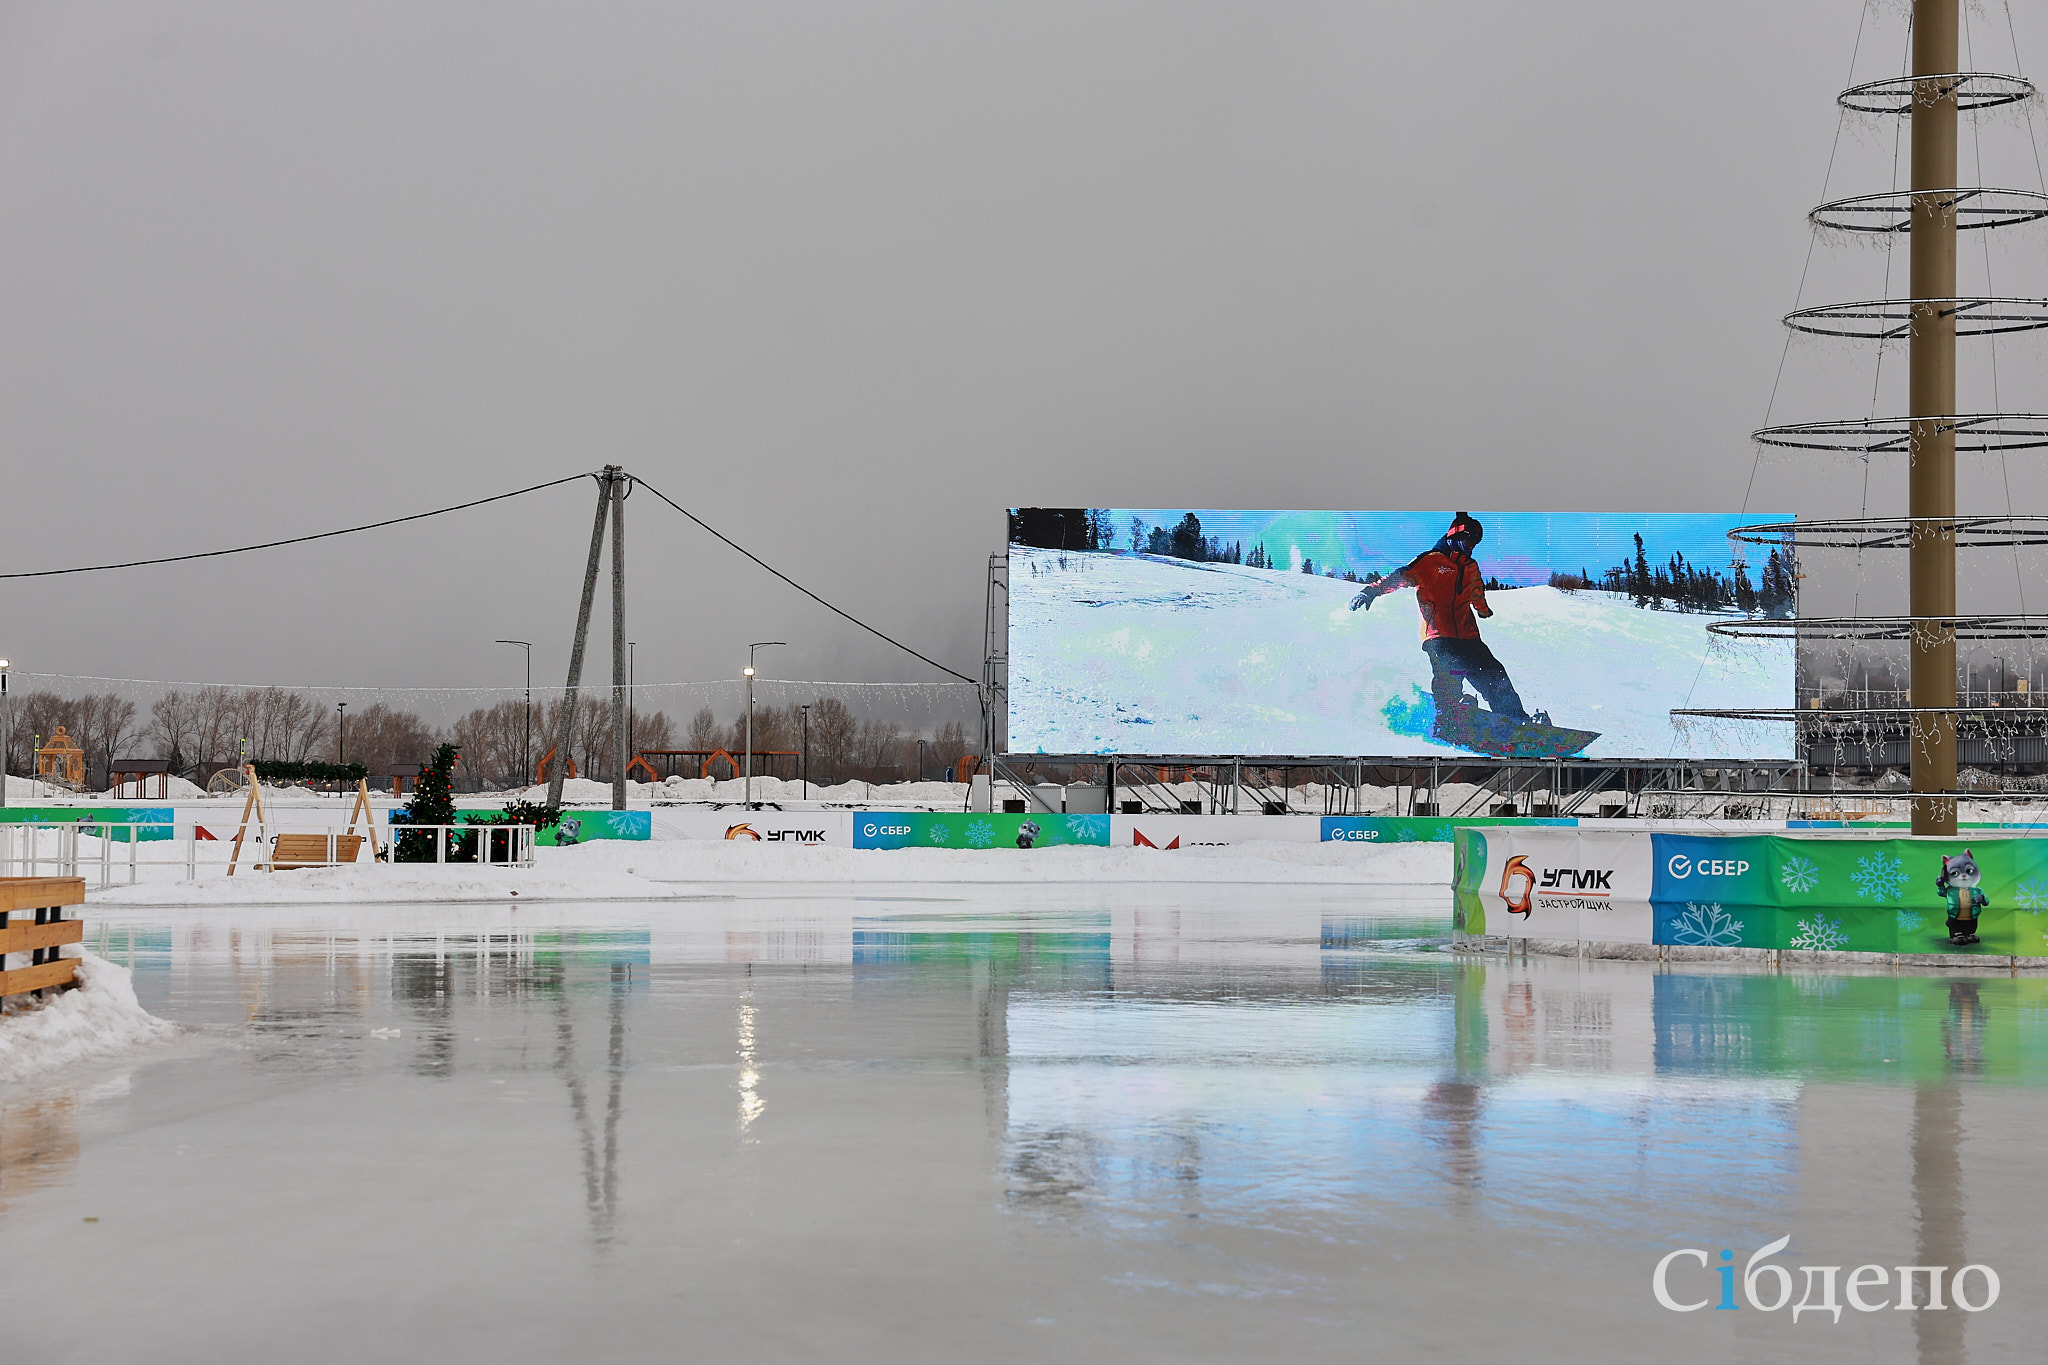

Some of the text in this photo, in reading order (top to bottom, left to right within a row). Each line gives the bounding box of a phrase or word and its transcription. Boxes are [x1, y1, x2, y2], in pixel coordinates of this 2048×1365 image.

[767, 830, 826, 841] УГМК
[880, 826, 911, 835] СБЕР
[1348, 830, 1379, 839] СБЕР
[1697, 859, 1750, 876] СБЕР
[1540, 868, 1614, 889] УГМК
[1538, 898, 1613, 911] ЗАСТРОЙЩИК
